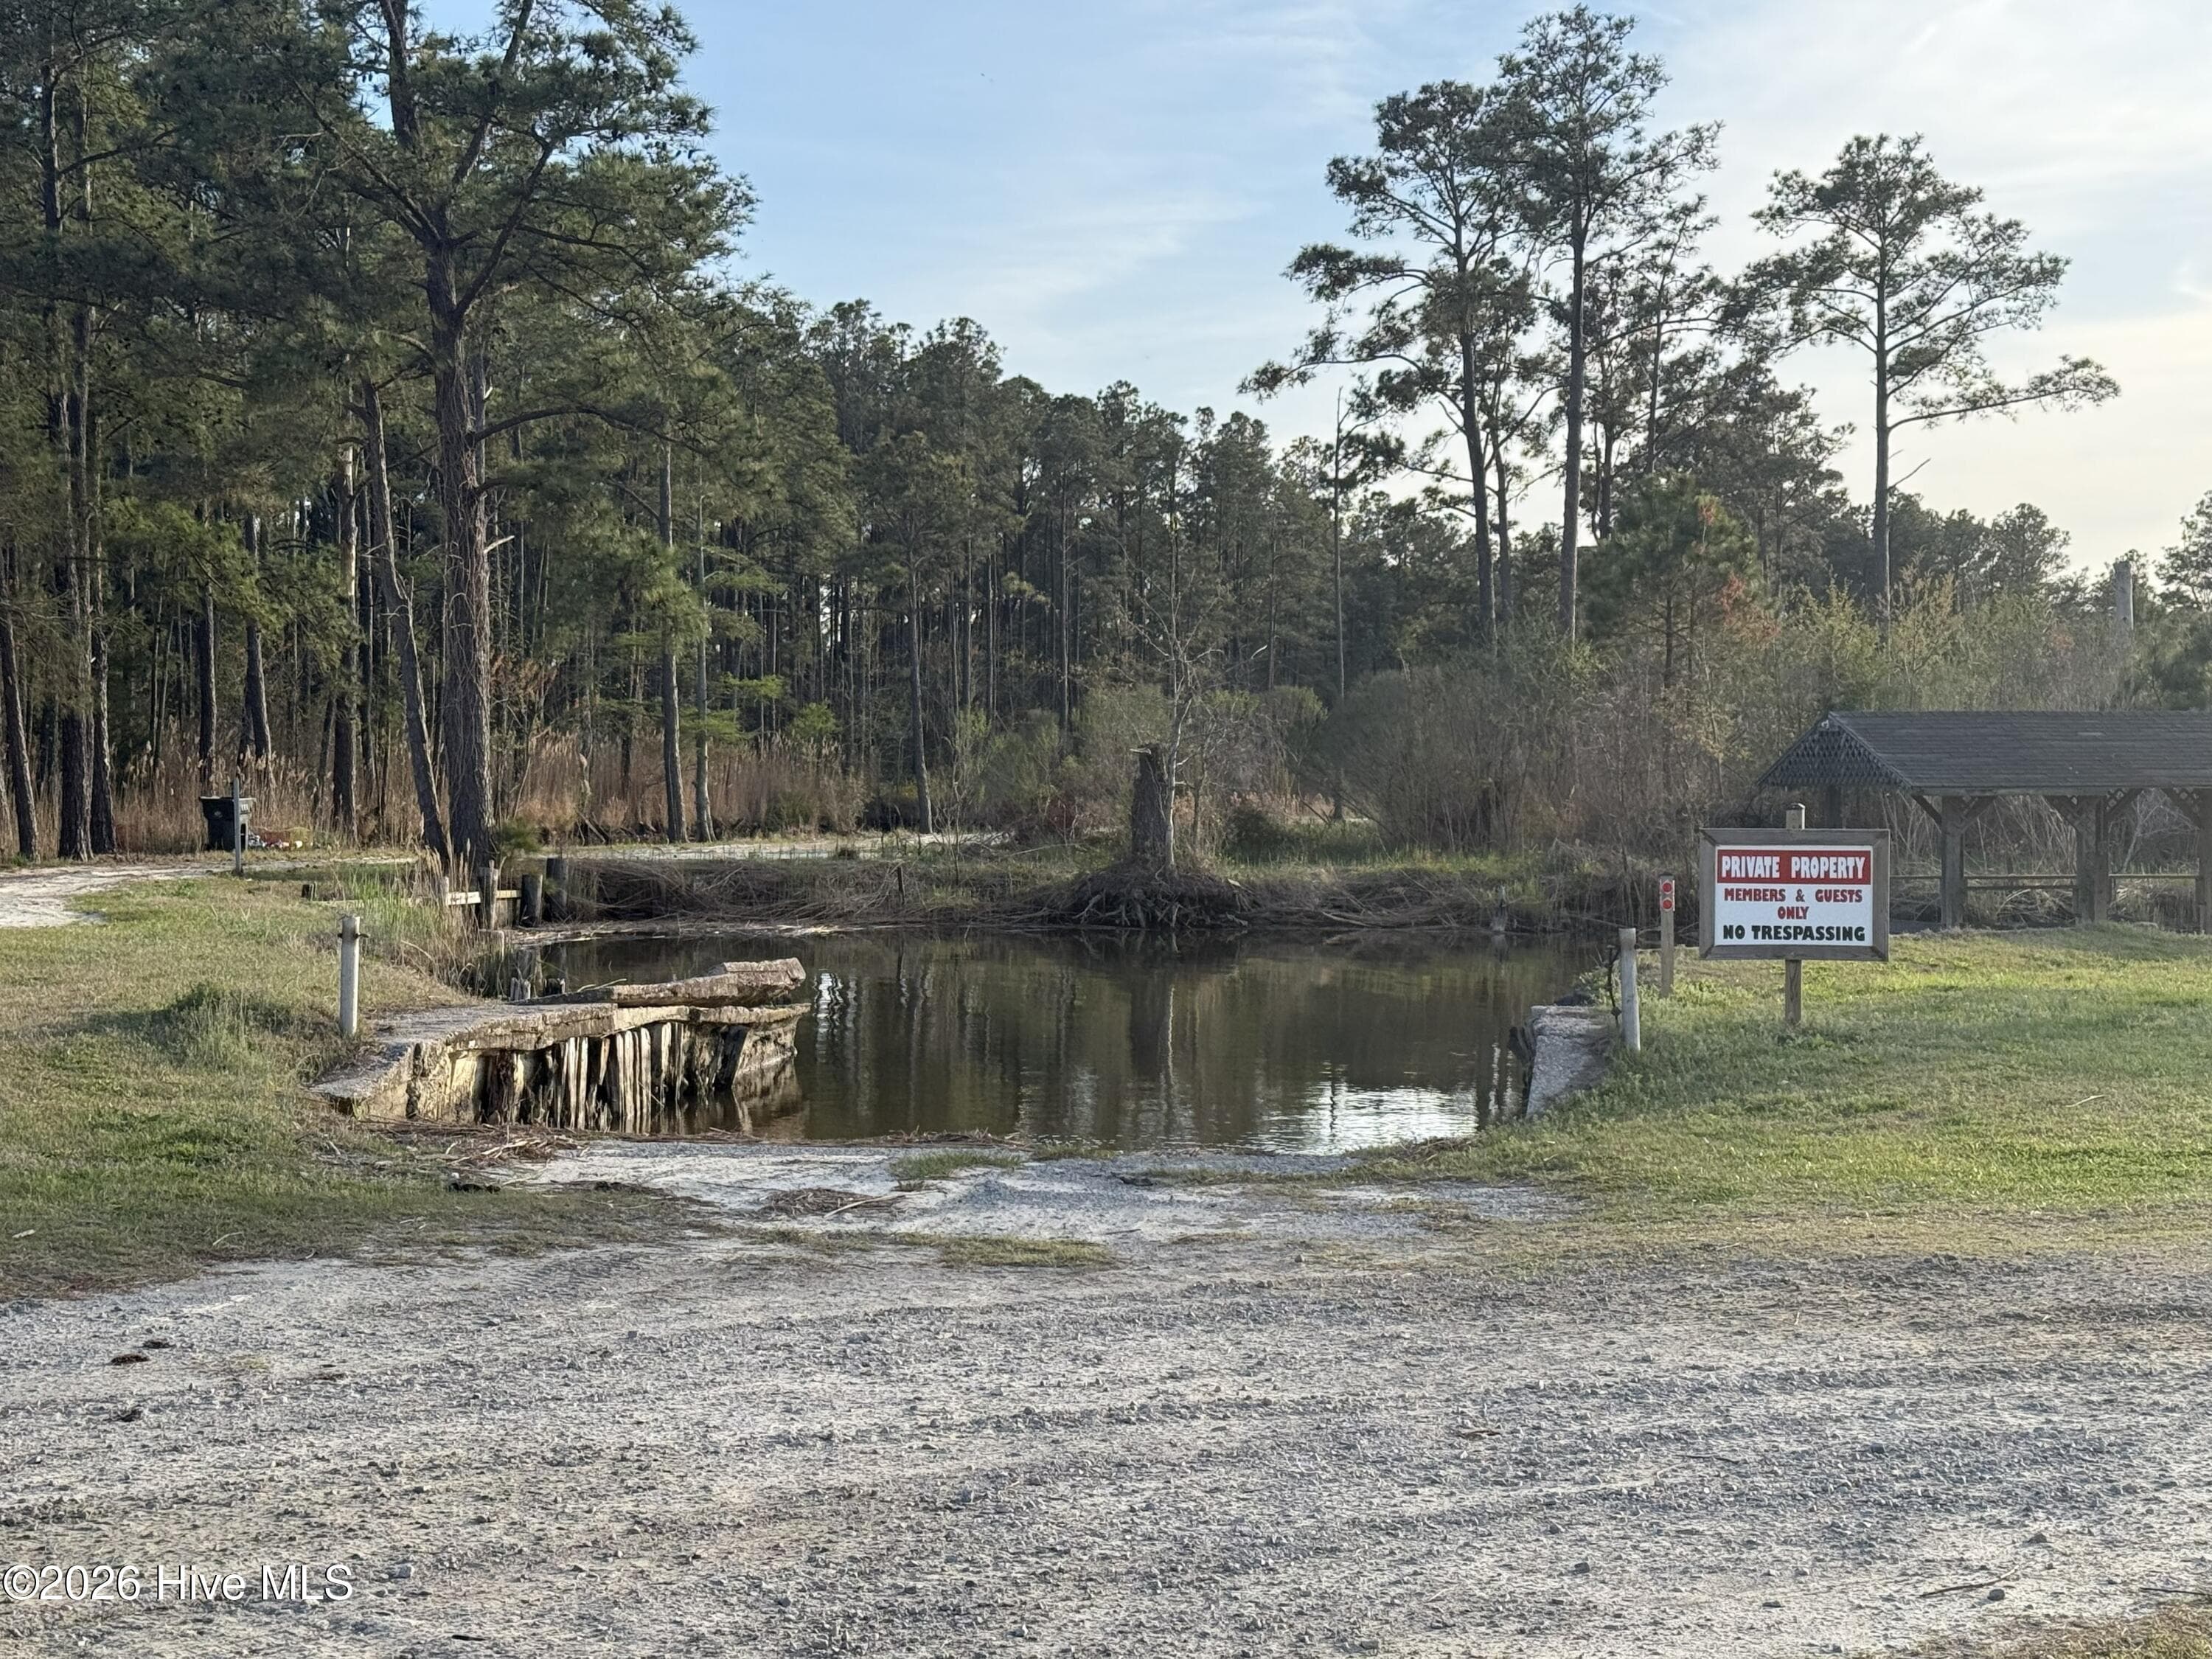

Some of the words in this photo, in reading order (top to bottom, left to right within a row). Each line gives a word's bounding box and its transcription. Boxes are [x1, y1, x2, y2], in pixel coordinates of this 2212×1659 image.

[1722, 855, 1780, 878] PRIVATE
[1791, 856, 1865, 879] PROPERTY
[1724, 888, 1786, 902] MEMBERS
[1795, 888, 1805, 902] &
[1815, 888, 1863, 903] GUESTS
[1777, 906, 1809, 919] ONLY
[1723, 925, 1745, 939] NO
[1751, 925, 1865, 942] TRESPASSING
